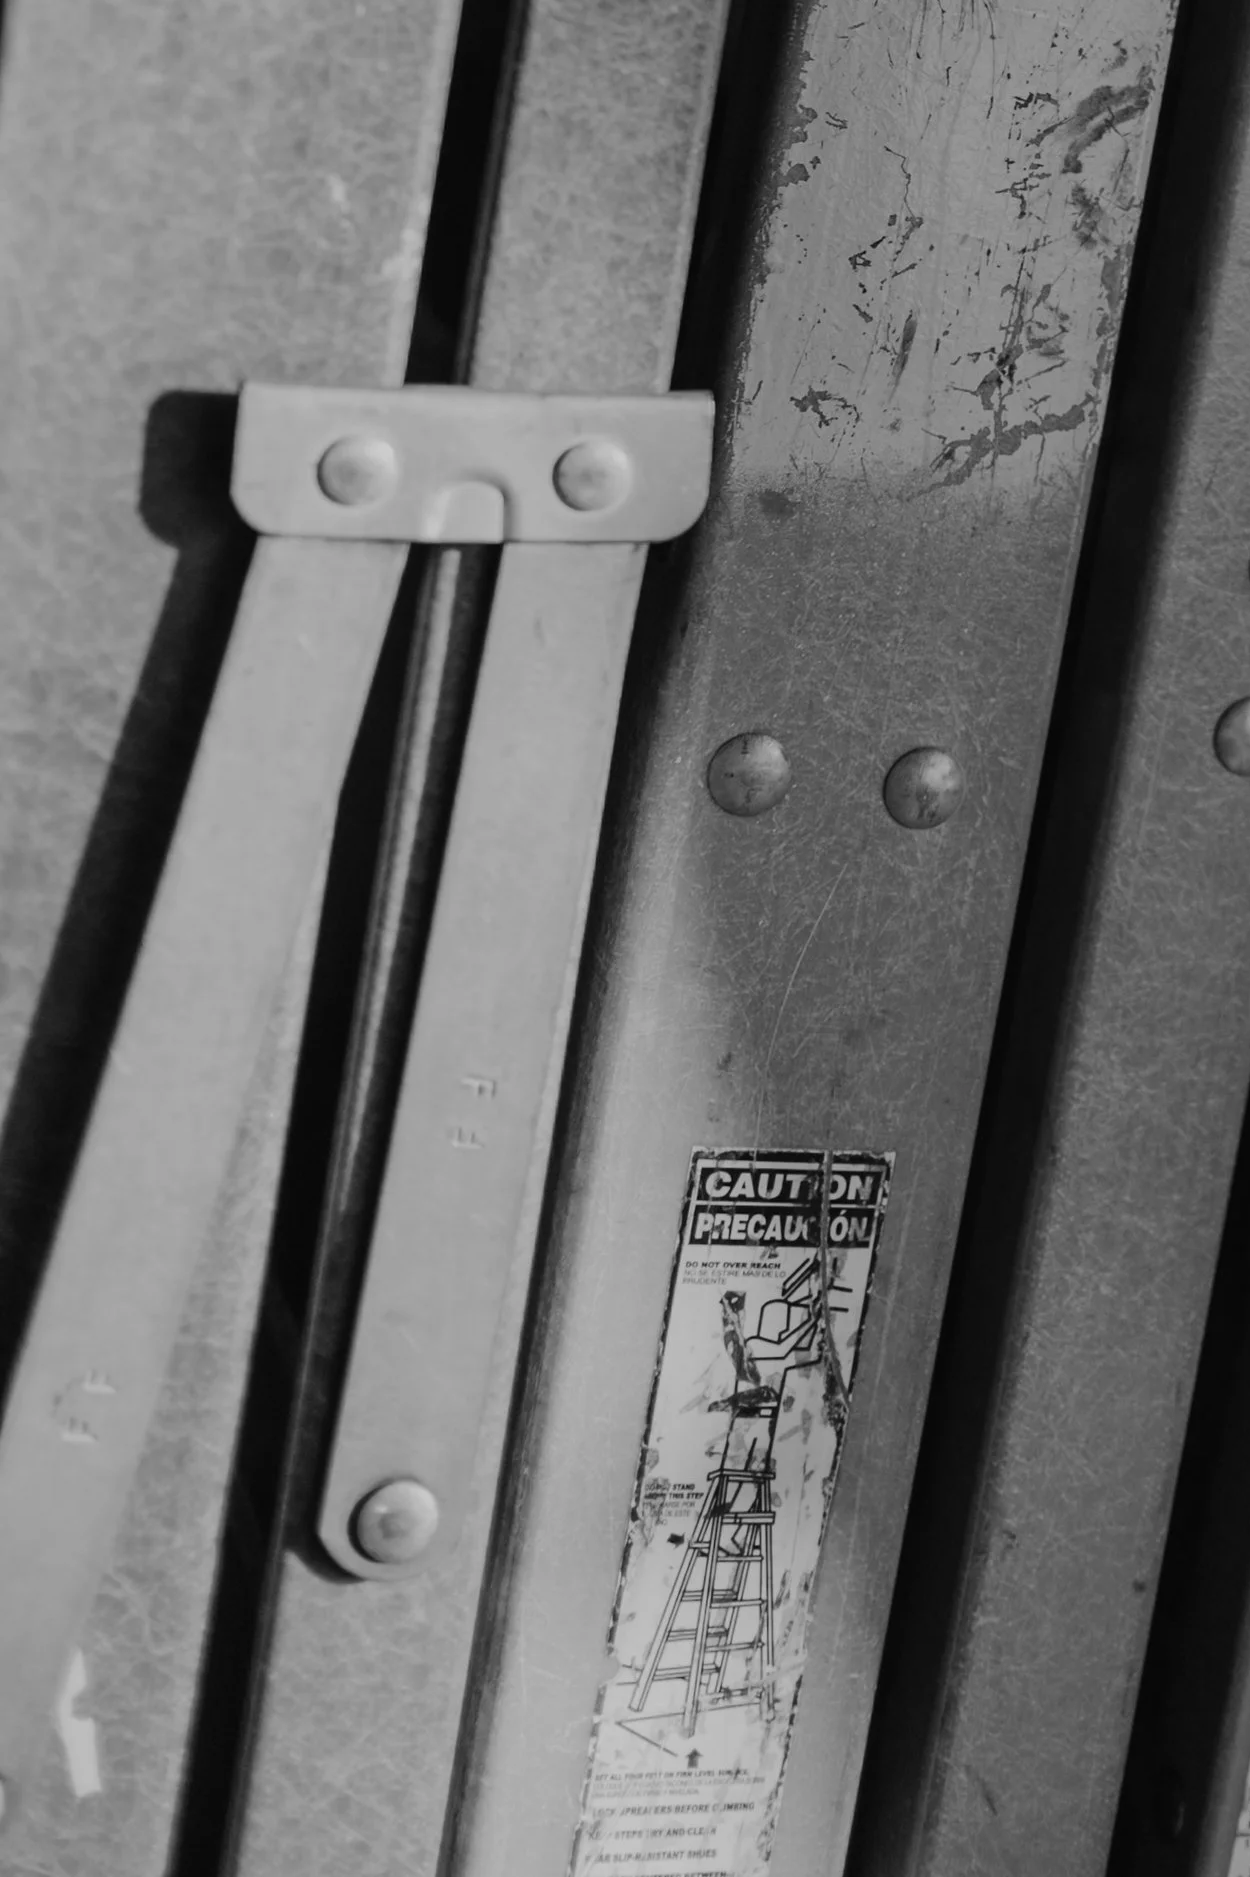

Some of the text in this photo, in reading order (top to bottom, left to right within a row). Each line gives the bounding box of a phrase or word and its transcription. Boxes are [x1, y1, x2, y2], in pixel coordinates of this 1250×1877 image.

[684, 1260, 699, 1268] DO
[721, 1261, 747, 1269] OVER
[749, 1262, 781, 1270] REACH
[671, 1483, 696, 1491] STAND
[674, 1803, 710, 1813] BEFORE
[665, 1827, 685, 1836] AND
